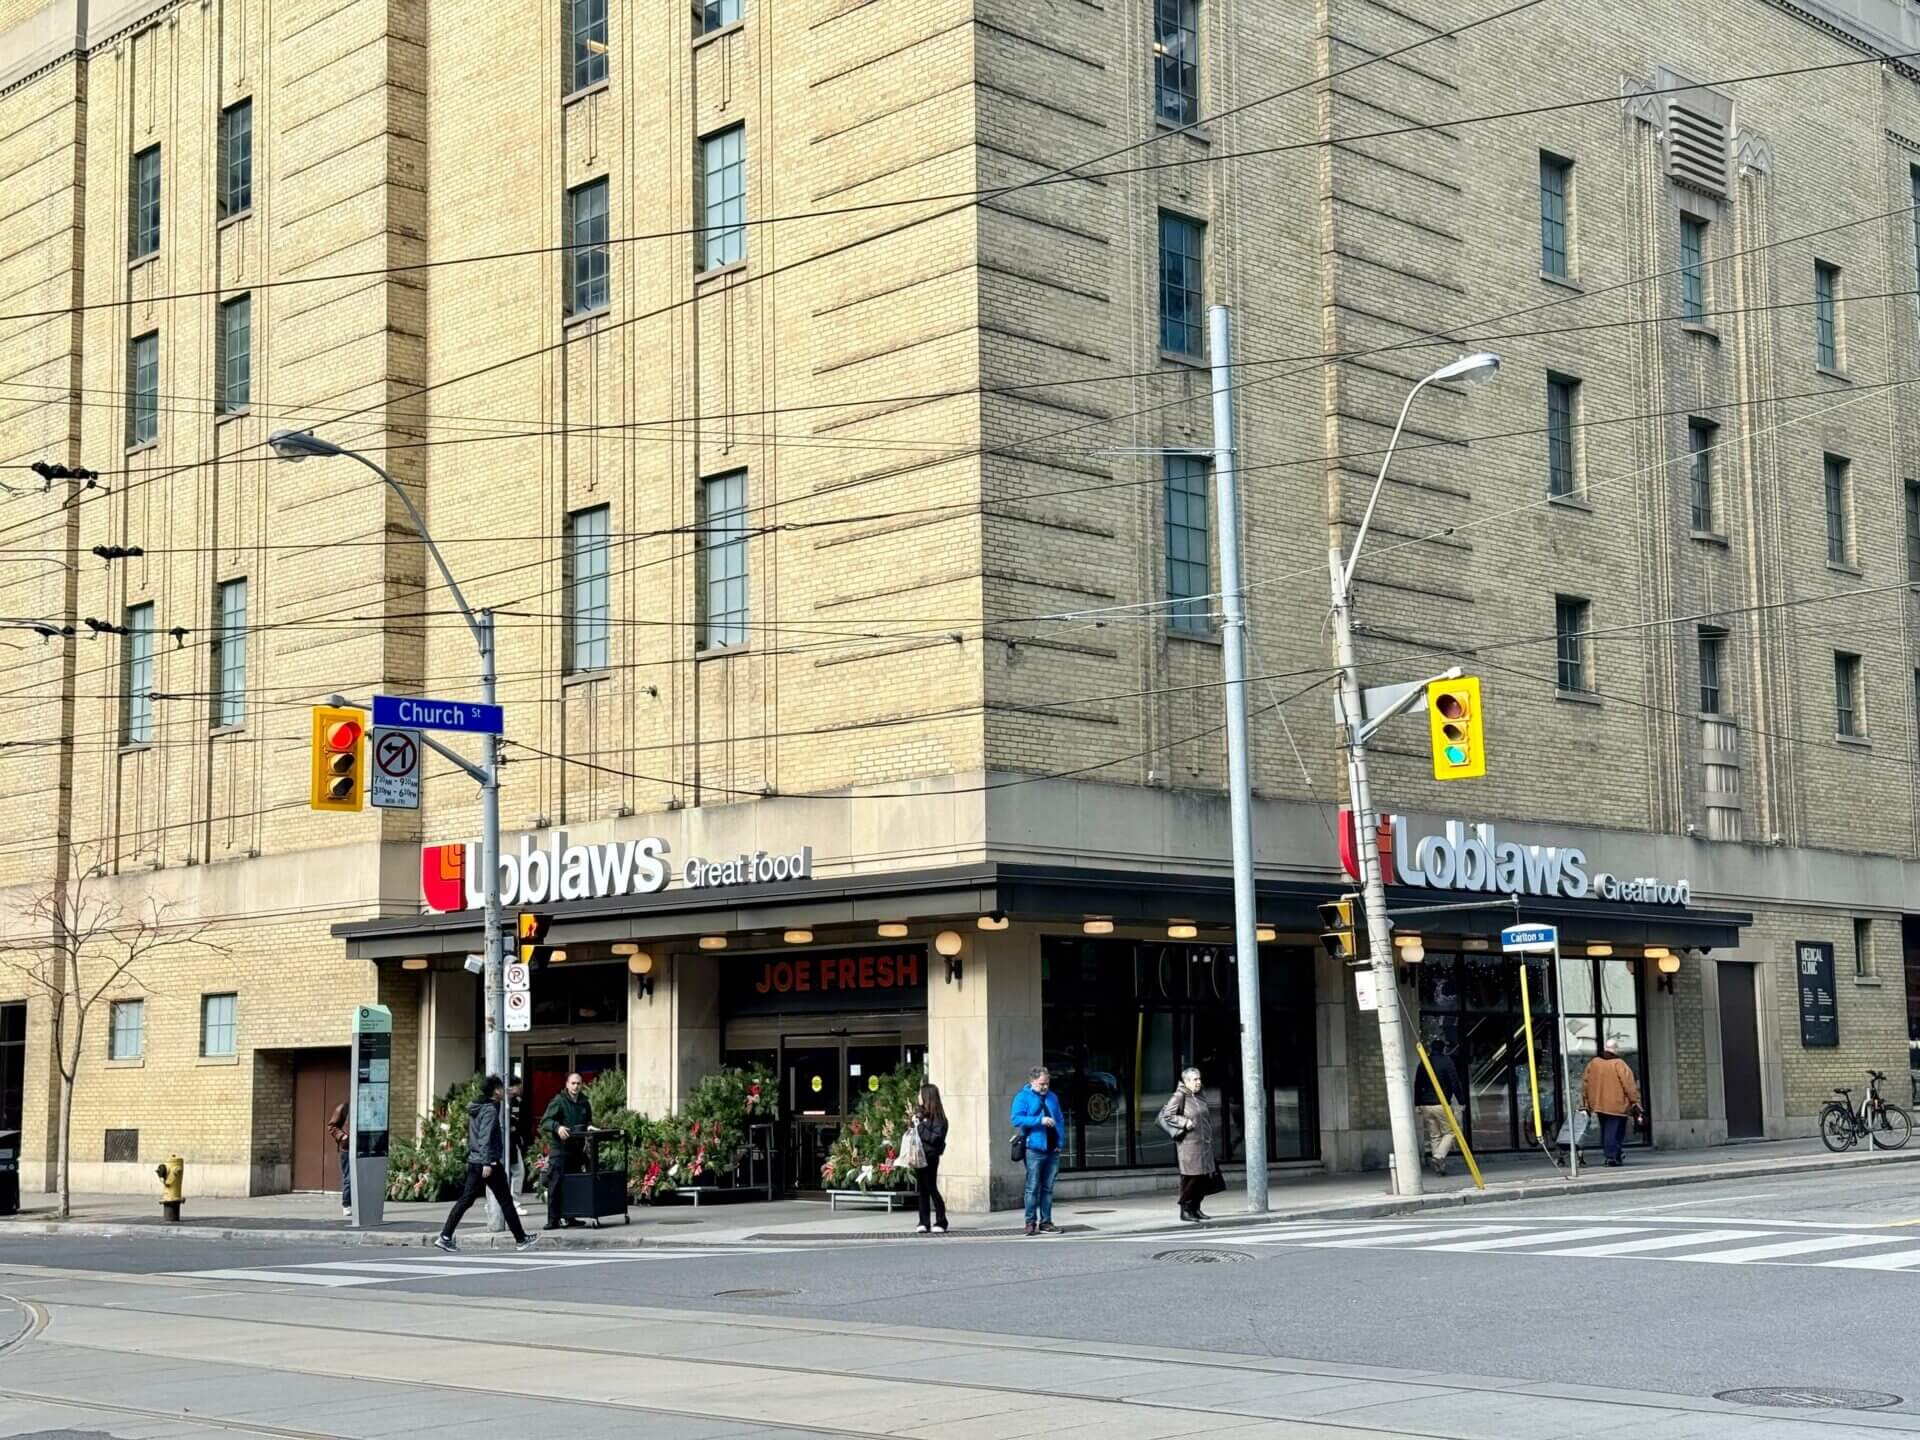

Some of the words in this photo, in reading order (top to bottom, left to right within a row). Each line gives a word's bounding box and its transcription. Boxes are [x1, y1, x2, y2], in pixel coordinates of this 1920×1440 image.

[399, 701, 464, 725] Church
[471, 707, 481, 718] St
[465, 831, 671, 910] Loblaws
[684, 855, 747, 889] Great
[750, 845, 811, 883] food
[1391, 815, 1588, 898] Loblaws
[1597, 873, 1649, 903] Great
[1649, 878, 1690, 905] food
[756, 961, 810, 993] JOE
[821, 954, 918, 990] FRESH
